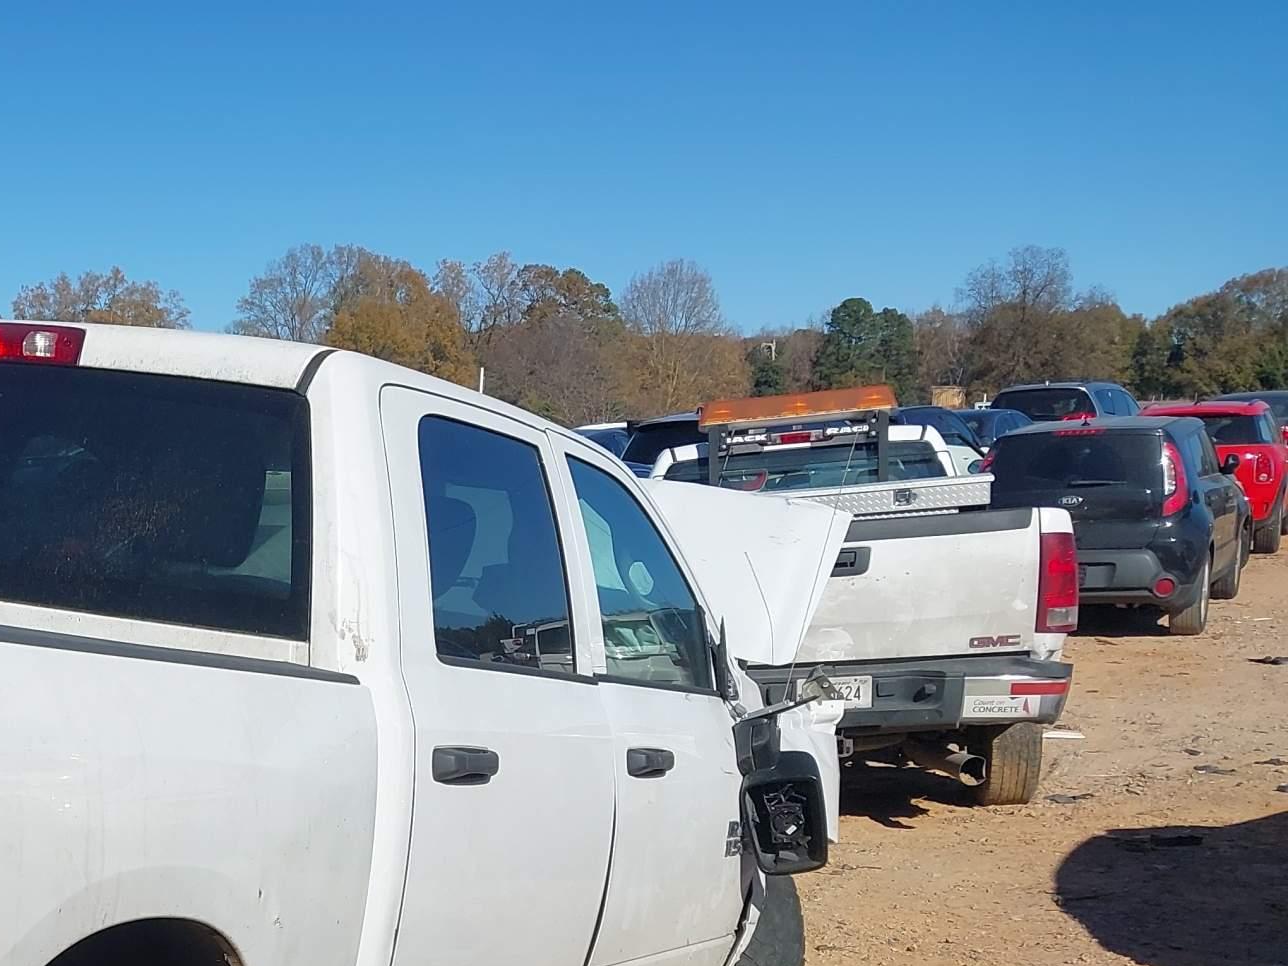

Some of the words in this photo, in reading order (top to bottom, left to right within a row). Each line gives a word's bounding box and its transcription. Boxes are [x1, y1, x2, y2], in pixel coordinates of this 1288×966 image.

[726, 433, 768, 444] ACK
[969, 634, 1021, 648] GMC
[972, 705, 1020, 713] CONCRETE
